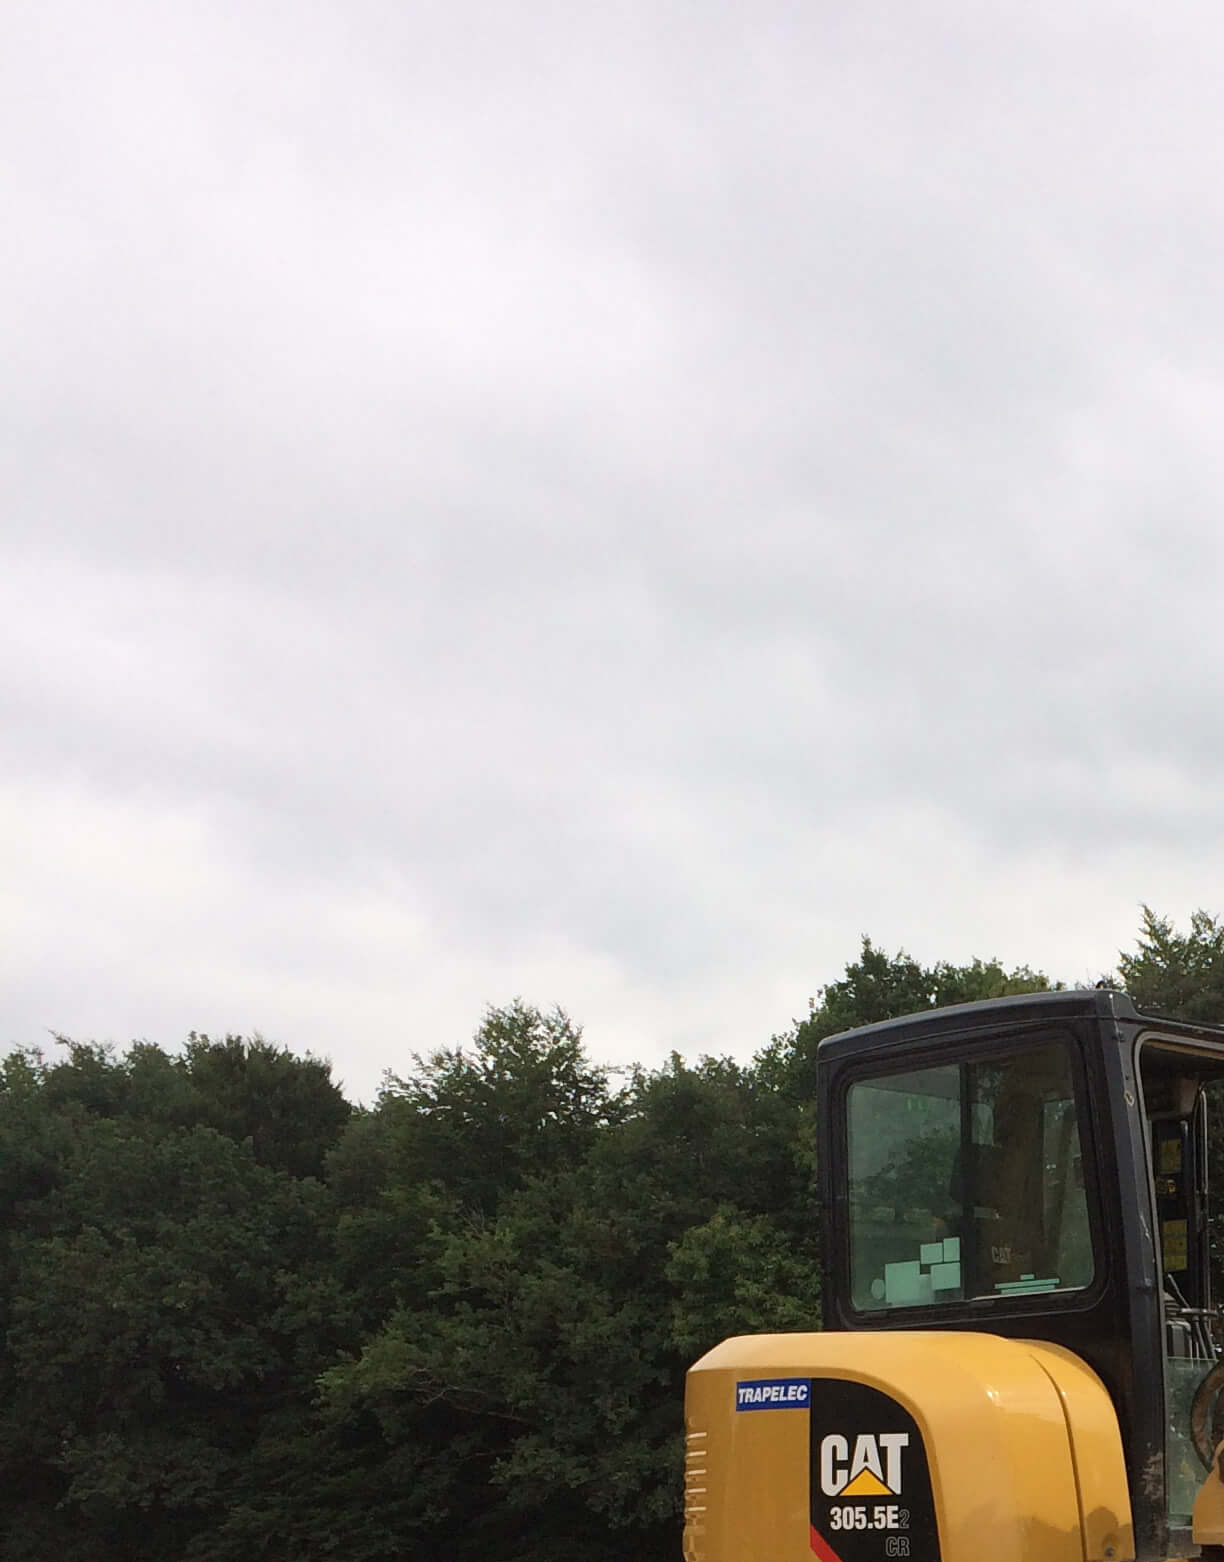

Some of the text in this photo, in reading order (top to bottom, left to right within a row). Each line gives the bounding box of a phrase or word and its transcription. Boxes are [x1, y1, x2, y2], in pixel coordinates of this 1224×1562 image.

[738, 1384, 808, 1404] TRAPELEC
[821, 1433, 909, 1496] CAT
[885, 1536, 910, 1557] CR
